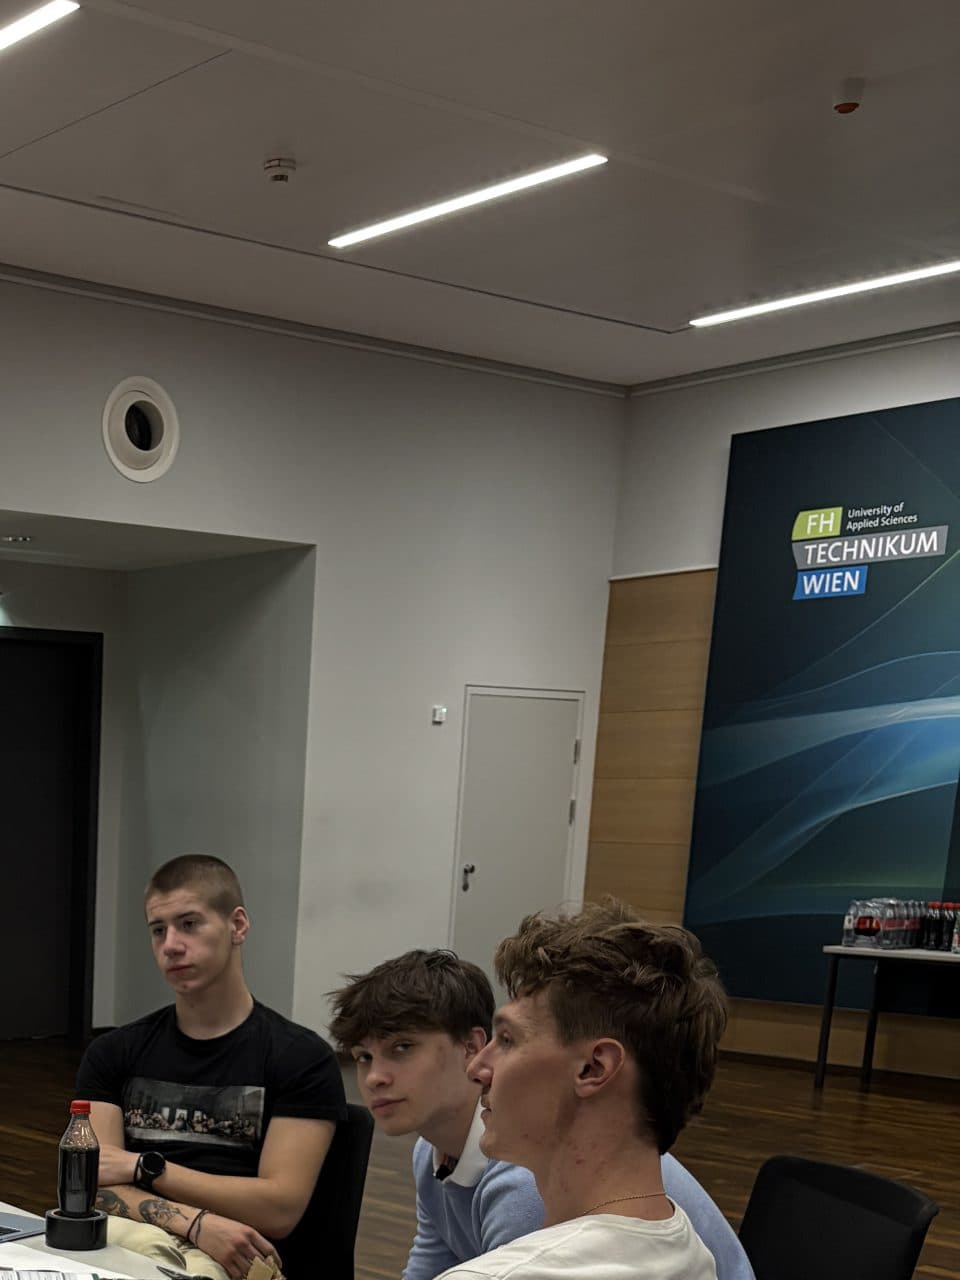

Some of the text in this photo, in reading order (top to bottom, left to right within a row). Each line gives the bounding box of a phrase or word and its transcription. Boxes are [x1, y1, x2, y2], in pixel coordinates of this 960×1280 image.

[848, 502, 904, 518] University of
[806, 512, 835, 534] FH
[846, 514, 918, 532] Applied Sciences
[804, 531, 938, 565] TECHNIKUM
[802, 570, 860, 595] WIEN
